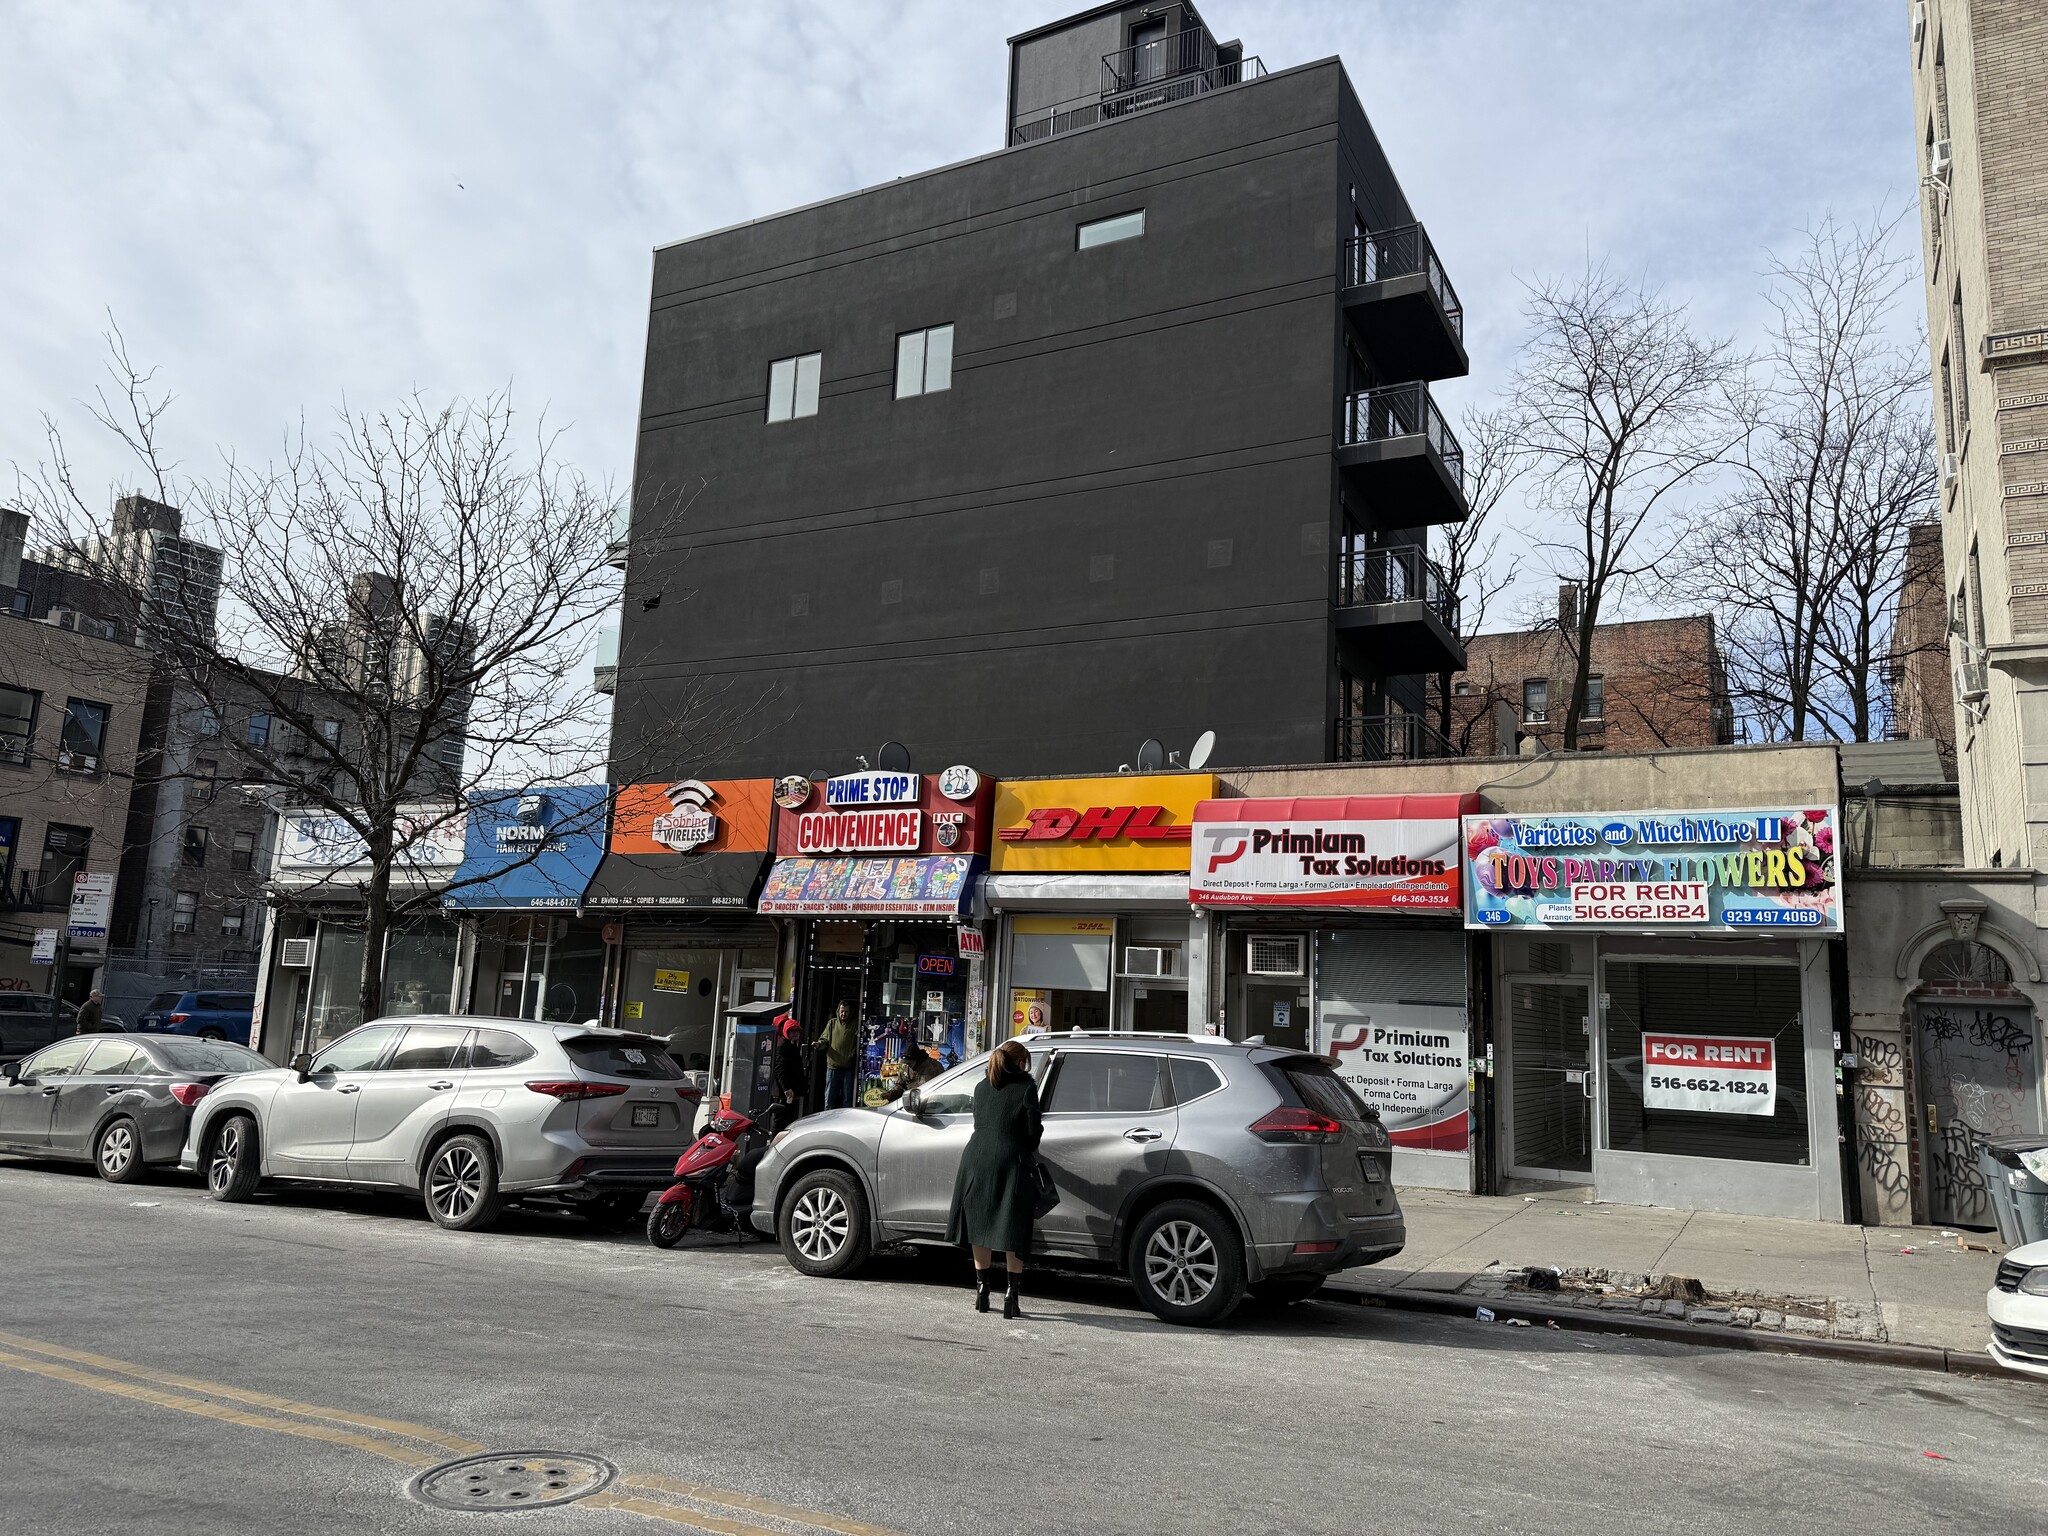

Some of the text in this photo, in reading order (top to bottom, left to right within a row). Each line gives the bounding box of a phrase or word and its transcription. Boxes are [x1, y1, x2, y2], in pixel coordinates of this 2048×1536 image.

[827, 776, 918, 803] PRIME STOP 1
[933, 813, 962, 822] INC
[1023, 806, 1173, 840] DHL
[496, 825, 544, 841] NORM
[664, 828, 706, 841] WIRELESS
[800, 812, 918, 849] CONVENIENCE
[1512, 817, 1782, 846] Varieties and Much More II
[496, 844, 516, 853] HAIR
[1252, 828, 1366, 854] Primium
[1299, 855, 1446, 876] Tax Solutions
[1489, 846, 1806, 889] TOYS PARTY FLOWERS
[1203, 880, 1448, 891] Direct Deposit Forma Larga Forma Corta Empleado Independiente
[1574, 884, 1704, 901] FOR RENT
[444, 899, 455, 907] 340
[775, 903, 799, 911] GROCERY
[803, 903, 825, 911] SNACKS
[829, 903, 848, 911] SODAS
[851, 903, 884, 911] HOUSEHOLD
[885, 903, 918, 911] ESSENTIALS
[1391, 895, 1449, 903] 646-360-3534
[1485, 911, 1501, 921] 346
[1574, 904, 1706, 919] 516.662.1824
[1727, 911, 1817, 922] 929 497 4068
[67, 929, 96, 937] 108901
[1076, 922, 1105, 931] DHL
[960, 932, 984, 952] ATM
[920, 957, 953, 973] OPEN
[1374, 1028, 1450, 1048] Primium
[1362, 1049, 1462, 1068] Tax Solutions
[1651, 1042, 1766, 1063] FOR RENT
[1357, 1075, 1389, 1087] Deposit
[1397, 1078, 1425, 1089] Forma
[1427, 1081, 1453, 1092] Larga
[1650, 1076, 1769, 1095] 516-662-1824
[1363, 1089, 1417, 1101] Forma Corta
[1382, 1102, 1445, 1116] Independiente
